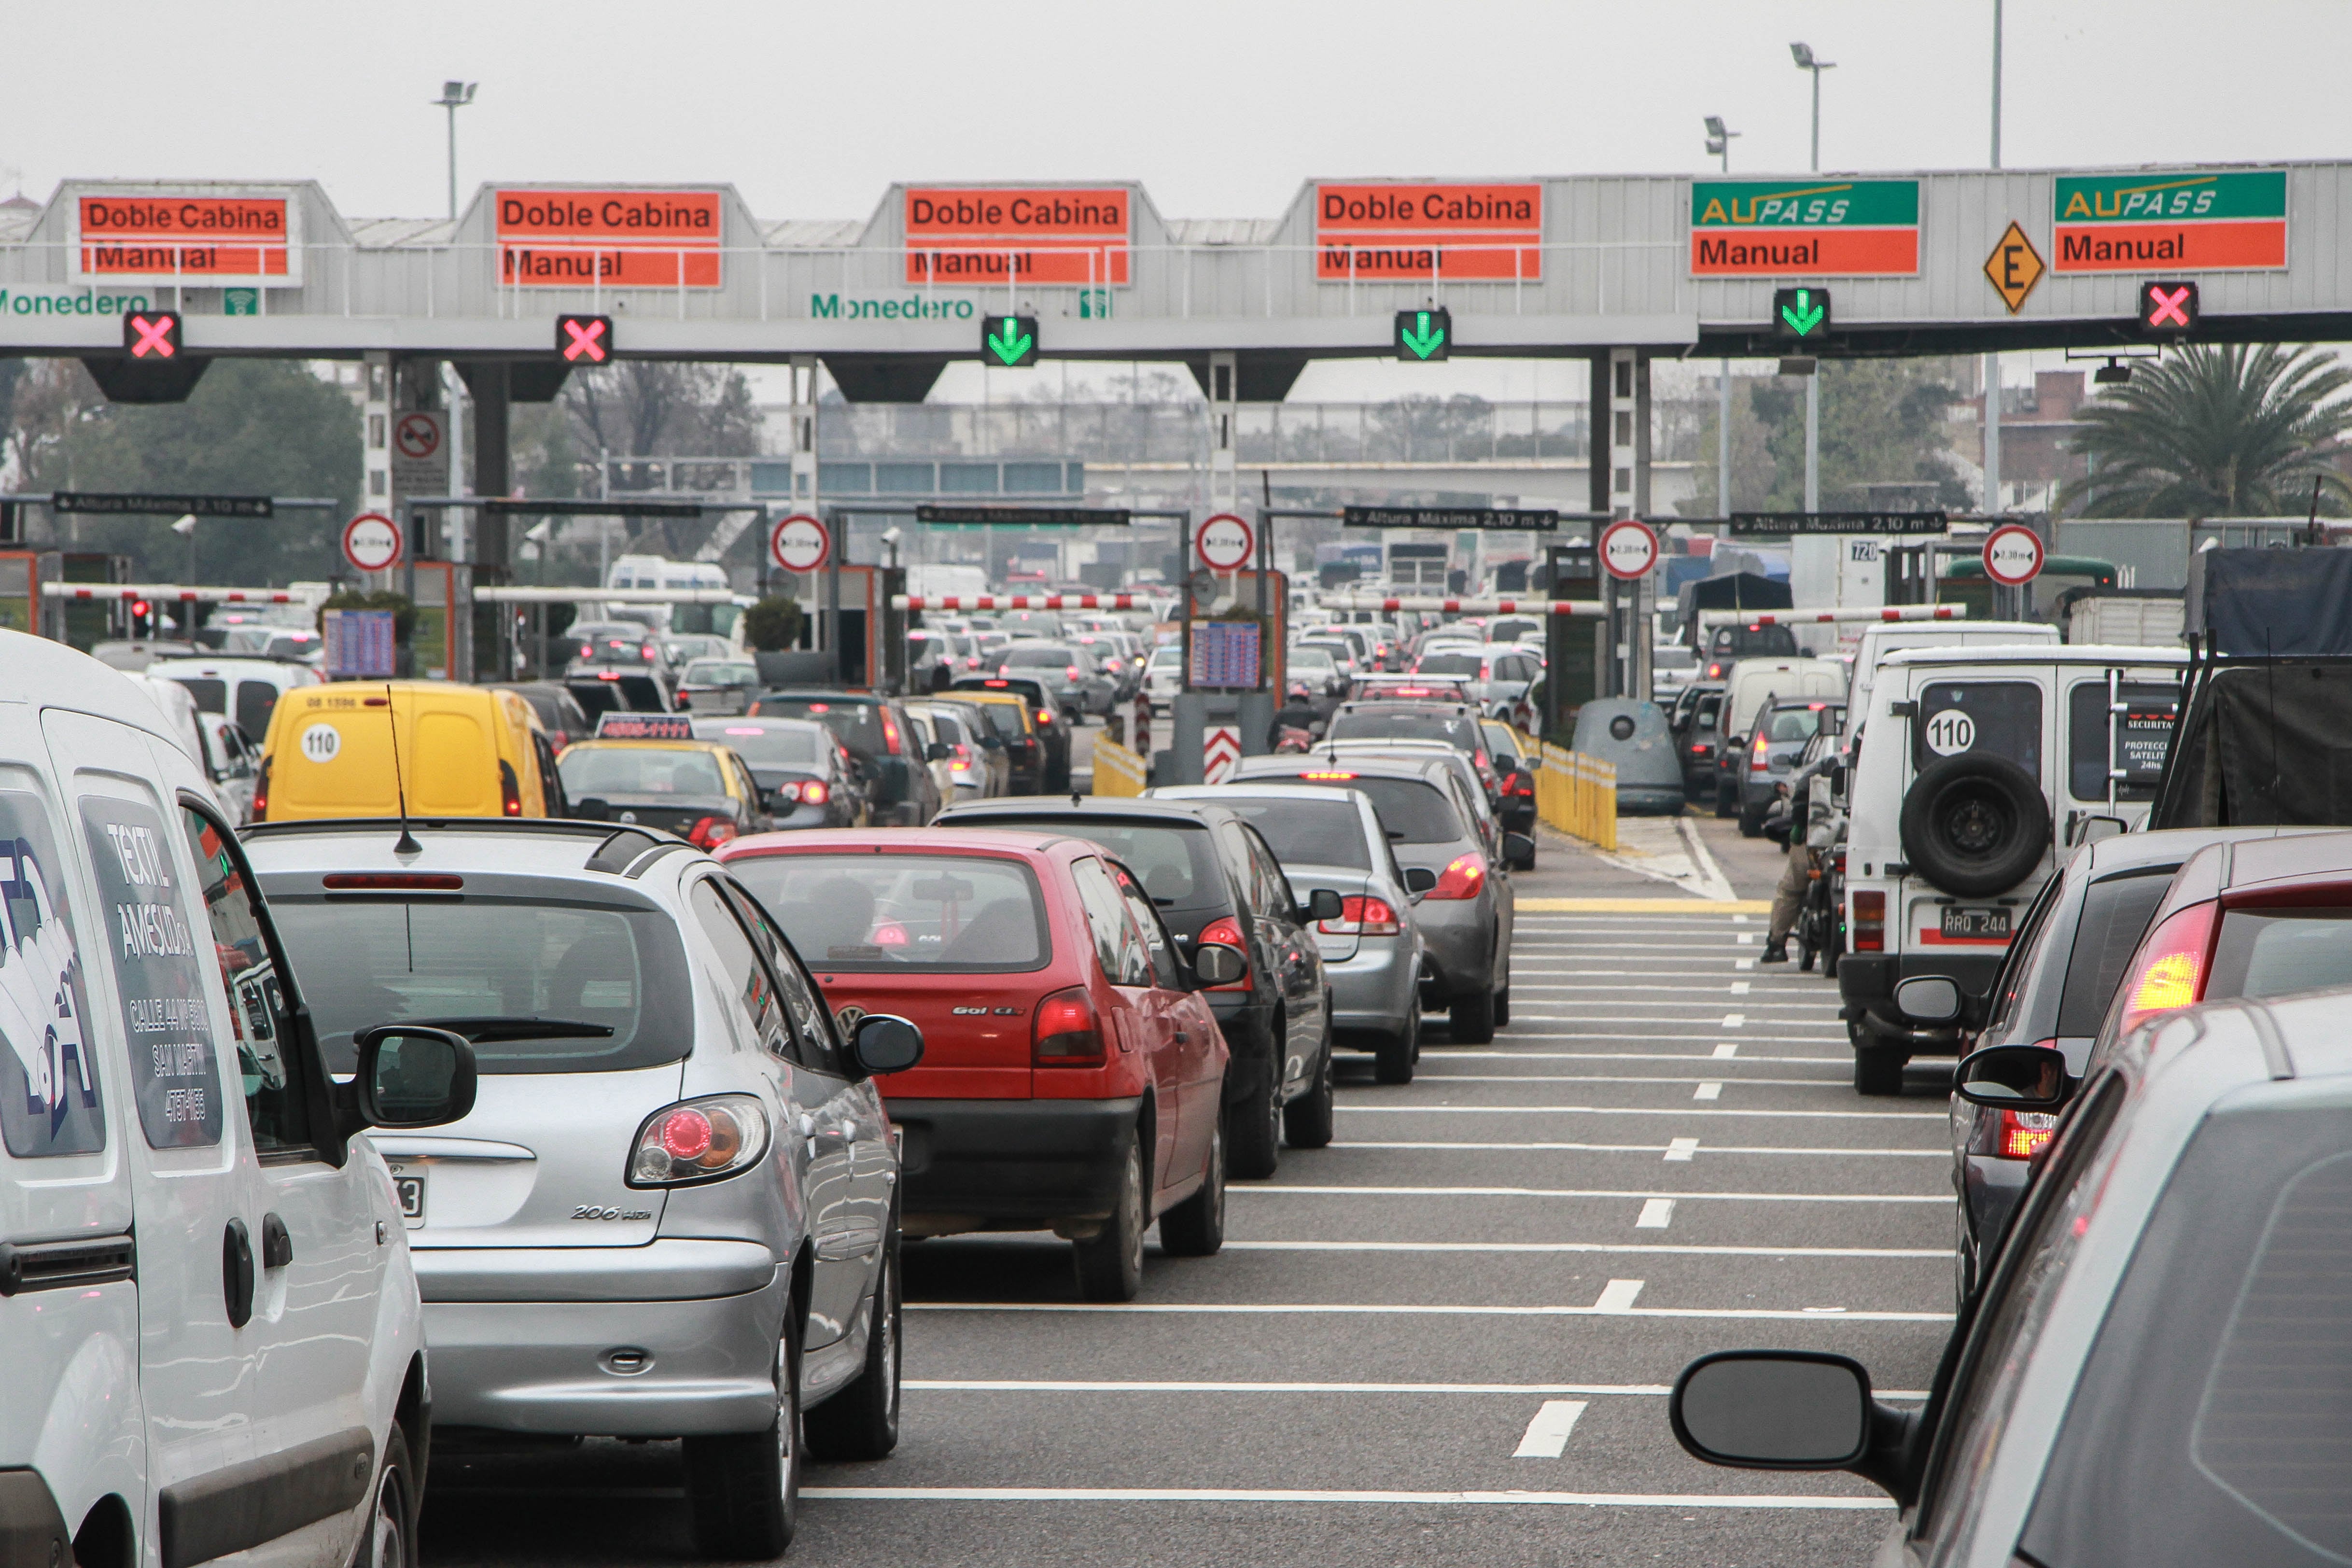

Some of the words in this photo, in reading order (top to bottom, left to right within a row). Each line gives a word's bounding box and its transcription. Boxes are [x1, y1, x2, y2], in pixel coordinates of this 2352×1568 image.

[89, 203, 171, 228] Doble
[180, 205, 279, 229] Cabina
[504, 200, 592, 225] Doble
[602, 201, 711, 227] Cabina
[913, 199, 1002, 224] Doble
[1010, 199, 1120, 225] Cabina
[1324, 195, 1413, 219] Doble
[1423, 194, 1531, 220] Cabina
[96, 243, 216, 268] Manual
[1700, 239, 1818, 265] Manual
[2063, 234, 2184, 261] Manual
[504, 246, 623, 276] Manual
[916, 252, 1031, 273] Manual
[2004, 246, 2025, 289] E
[0, 287, 149, 315] onedero
[811, 294, 973, 319] Monedero
[1367, 511, 1412, 524] Altura
[1520, 516, 1535, 526] m
[1910, 520, 1924, 530] m
[1852, 542, 1877, 560] 720
[307, 732, 335, 754] 110
[1931, 719, 1971, 747] 110
[2125, 741, 2167, 750] PROTECCI
[2129, 751, 2165, 759] SATELIT
[1980, 915, 2006, 933] 244
[129, 999, 165, 1034] CALLE
[952, 1006, 988, 1015] Gol
[152, 1043, 175, 1078] SAN
[571, 1204, 620, 1220] 206
